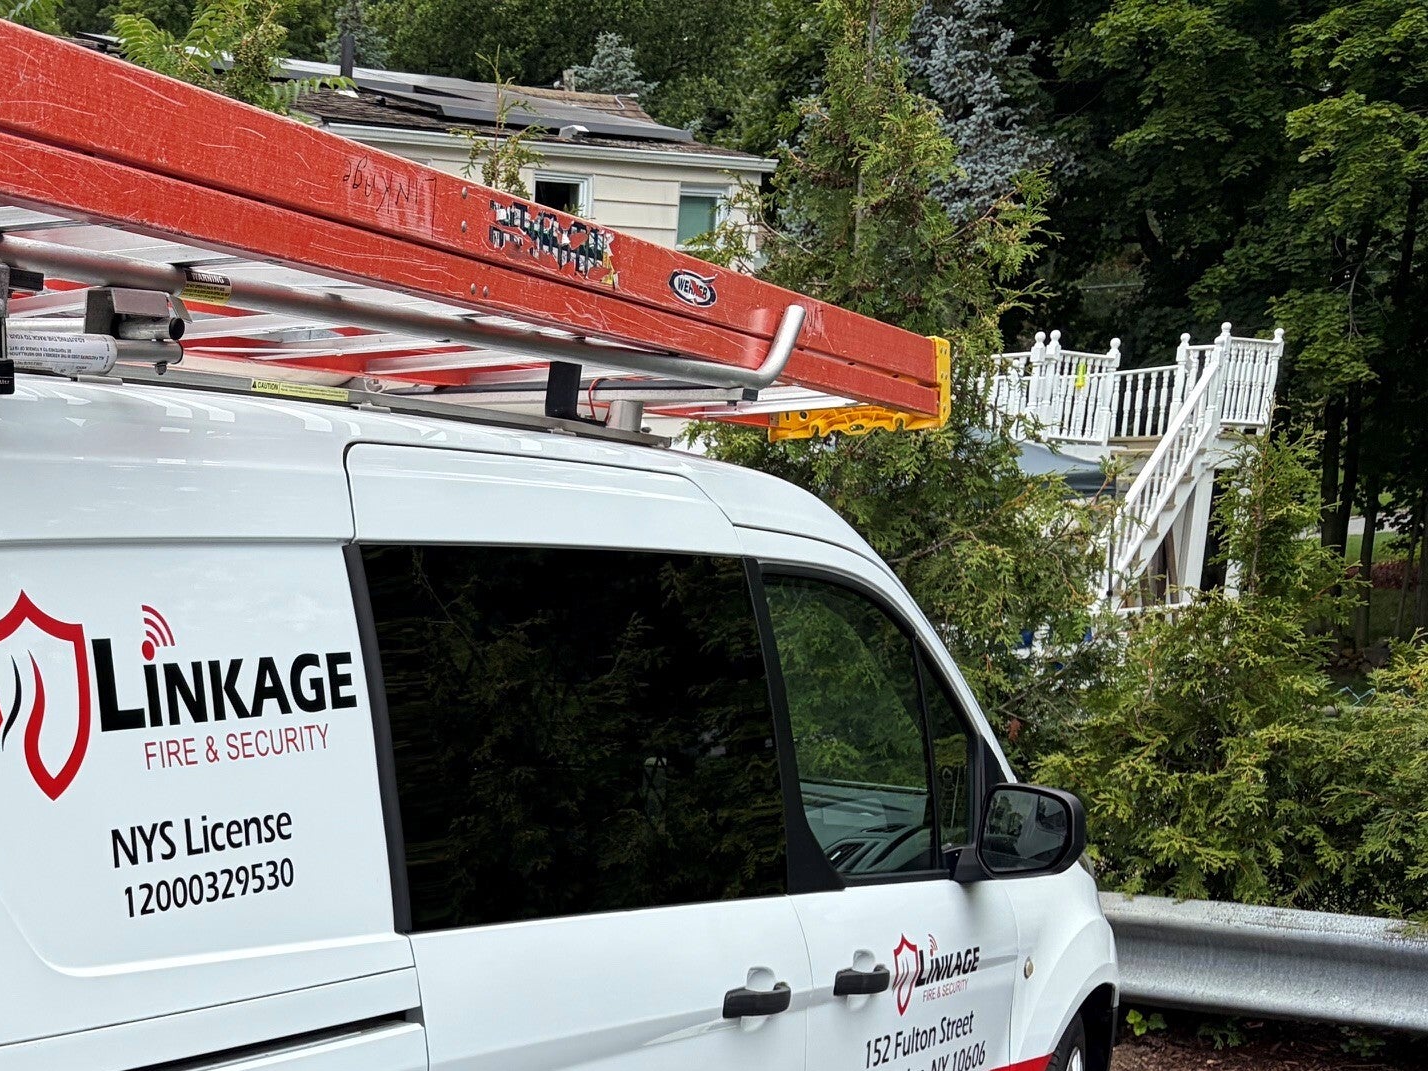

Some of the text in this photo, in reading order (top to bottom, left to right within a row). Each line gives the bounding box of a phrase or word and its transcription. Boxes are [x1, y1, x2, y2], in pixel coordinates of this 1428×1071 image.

[257, 381, 279, 391] CAUTION
[144, 723, 329, 770] FIRE & SECURITY
[110, 810, 293, 869] NYS License
[124, 857, 295, 918] 12000329530
[922, 987, 936, 1003] FIRE
[941, 978, 969, 997] SECURITY
[866, 1010, 975, 1069] 152 Fulton Street
